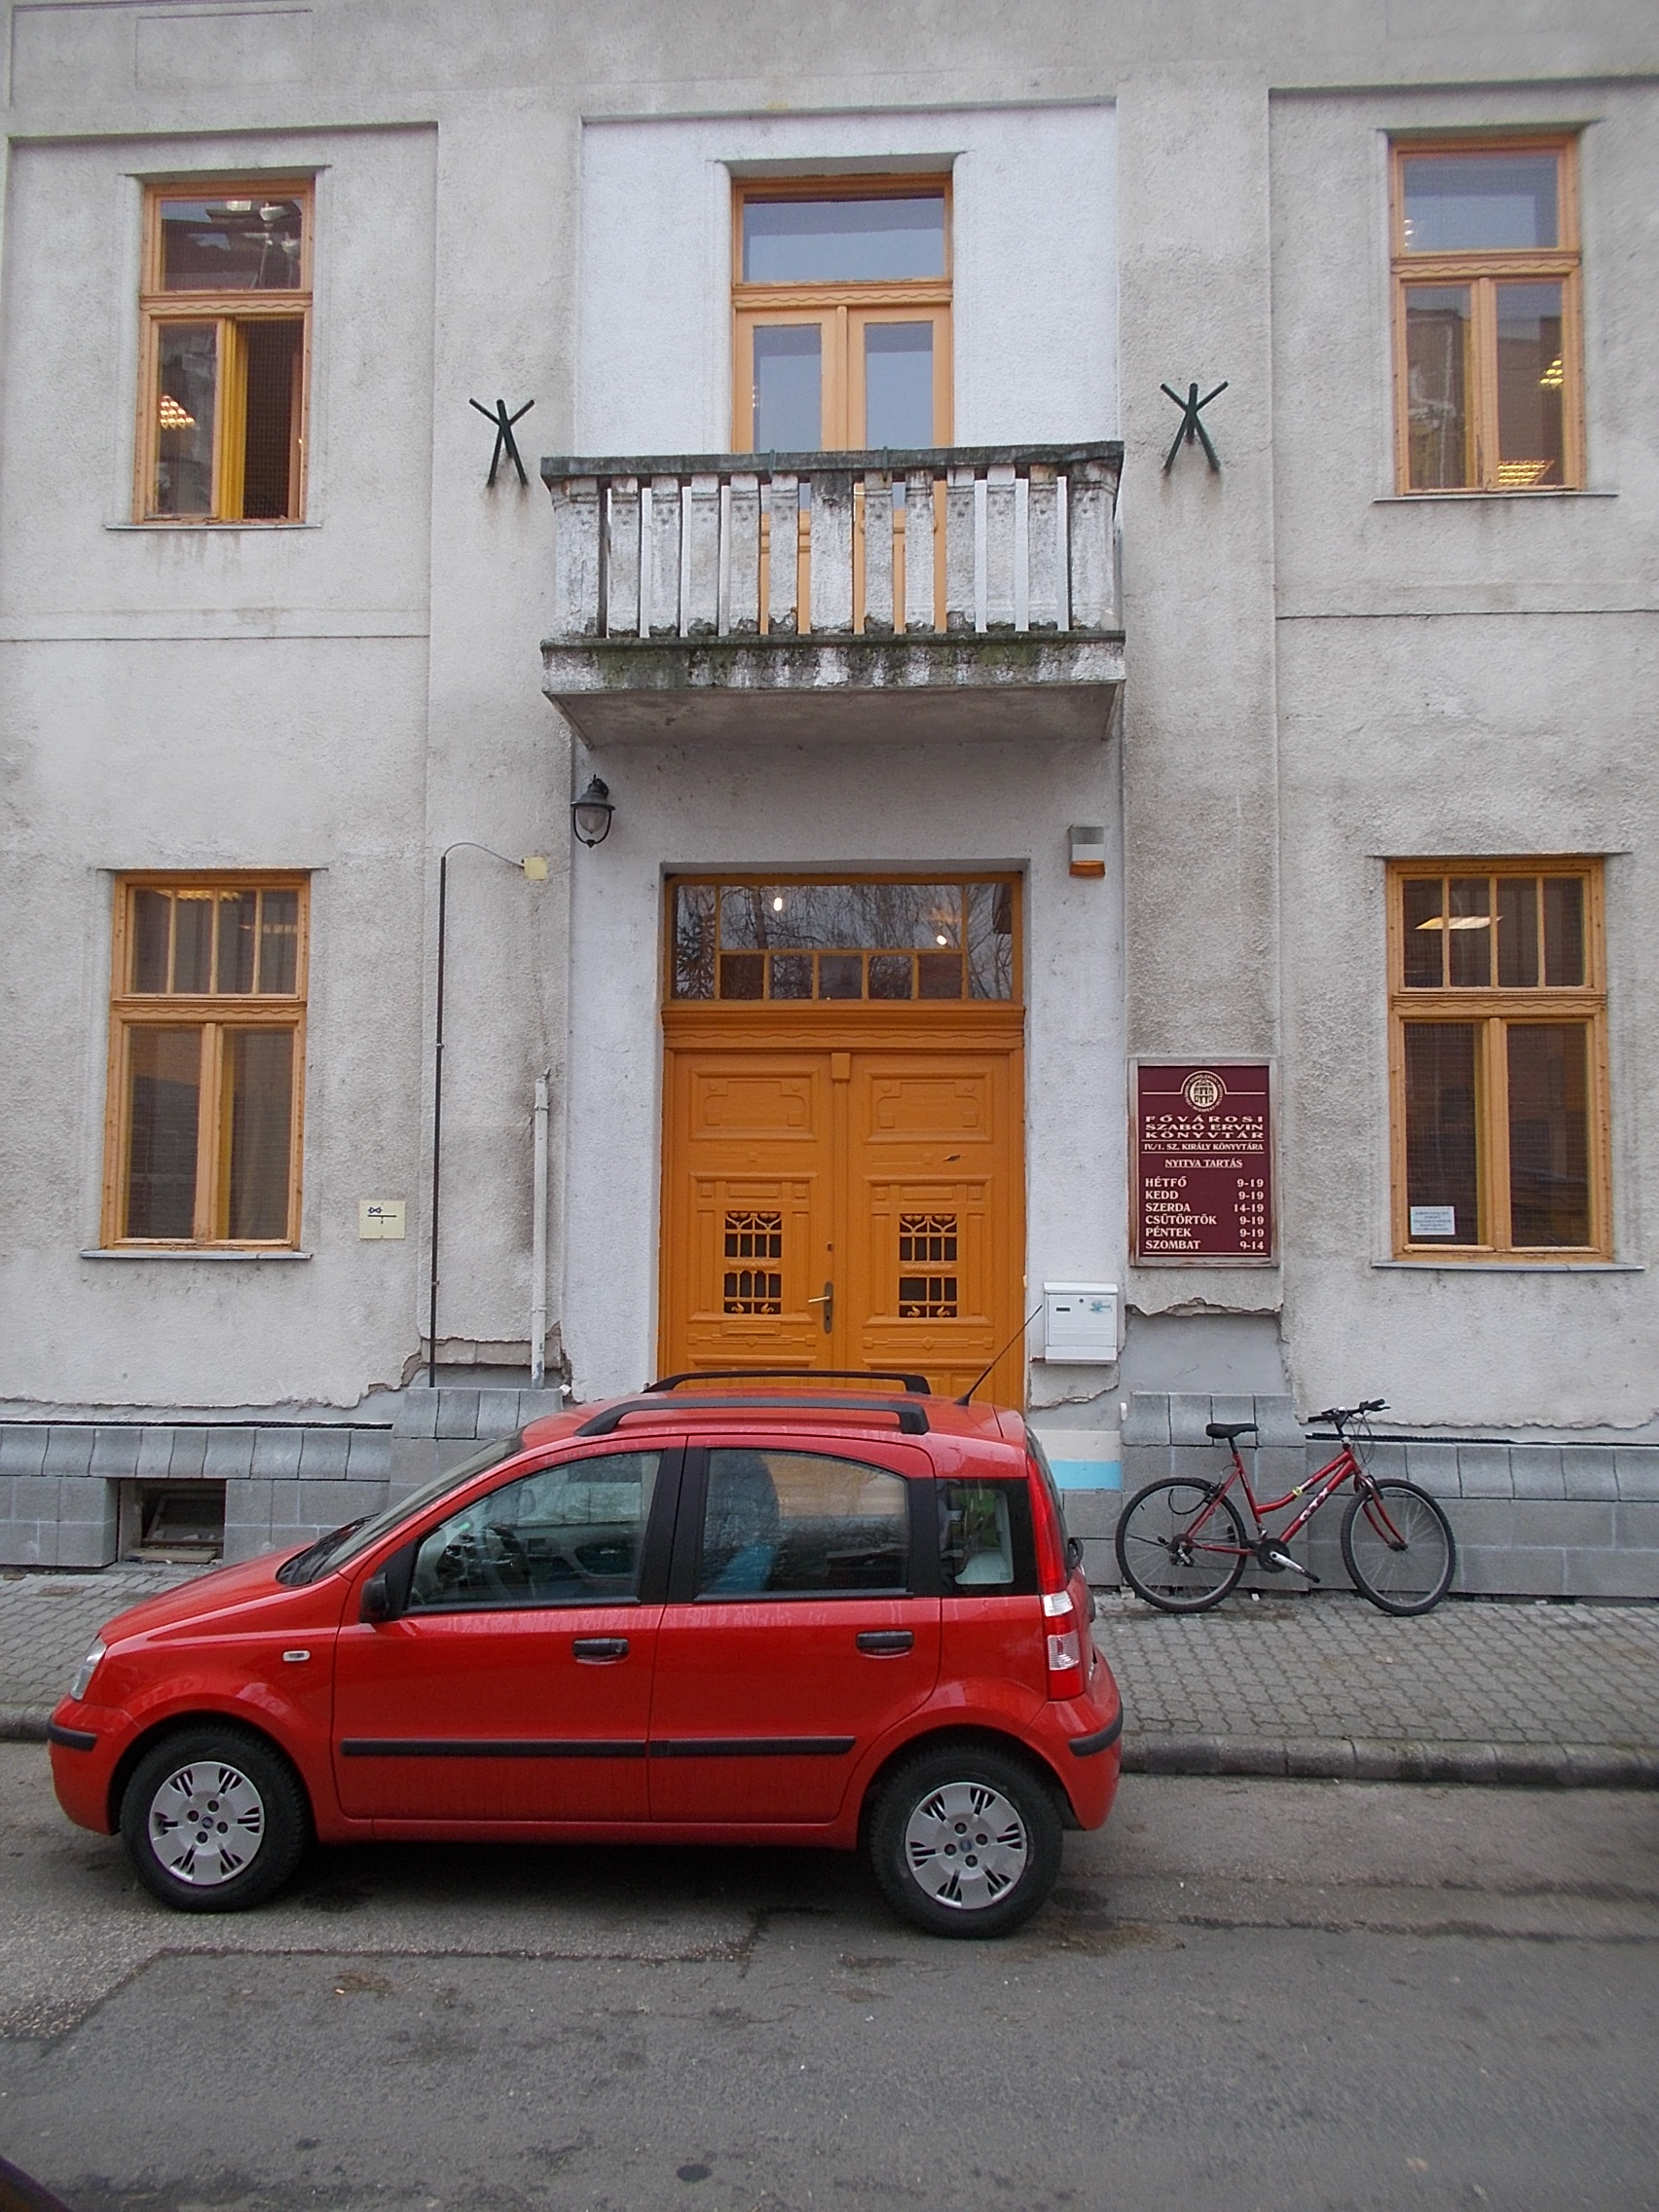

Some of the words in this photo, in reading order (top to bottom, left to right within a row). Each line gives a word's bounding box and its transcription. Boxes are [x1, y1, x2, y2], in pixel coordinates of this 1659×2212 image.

[1145, 1114, 1264, 1123] FŐVÁROSI
[1145, 1123, 1205, 1131] SZABÓ
[1145, 1130, 1264, 1139] KÖNYVTÁR
[1181, 1142, 1211, 1151] KIRÁLY
[1212, 1142, 1264, 1151] KÖNYVTÁRA
[1164, 1159, 1201, 1167] NYITVA
[1203, 1158, 1243, 1167] TARTÁS
[1145, 1175, 1188, 1188] HÉTFŐ
[1236, 1178, 1264, 1188] 9-19
[1145, 1190, 1179, 1199] KEDD
[1237, 1191, 1264, 1200] 9-19
[1145, 1202, 1192, 1212] SZERDA
[1234, 1203, 1265, 1213] 14-19
[1145, 1213, 1217, 1225] CSÜTÖRTÖK
[1239, 1216, 1265, 1225] 9-19
[1145, 1225, 1192, 1237] PÉNTEK
[1239, 1228, 1265, 1237] 9-19
[1145, 1239, 1201, 1250] SZOMBAT
[1239, 1240, 1265, 1250] 9-14
